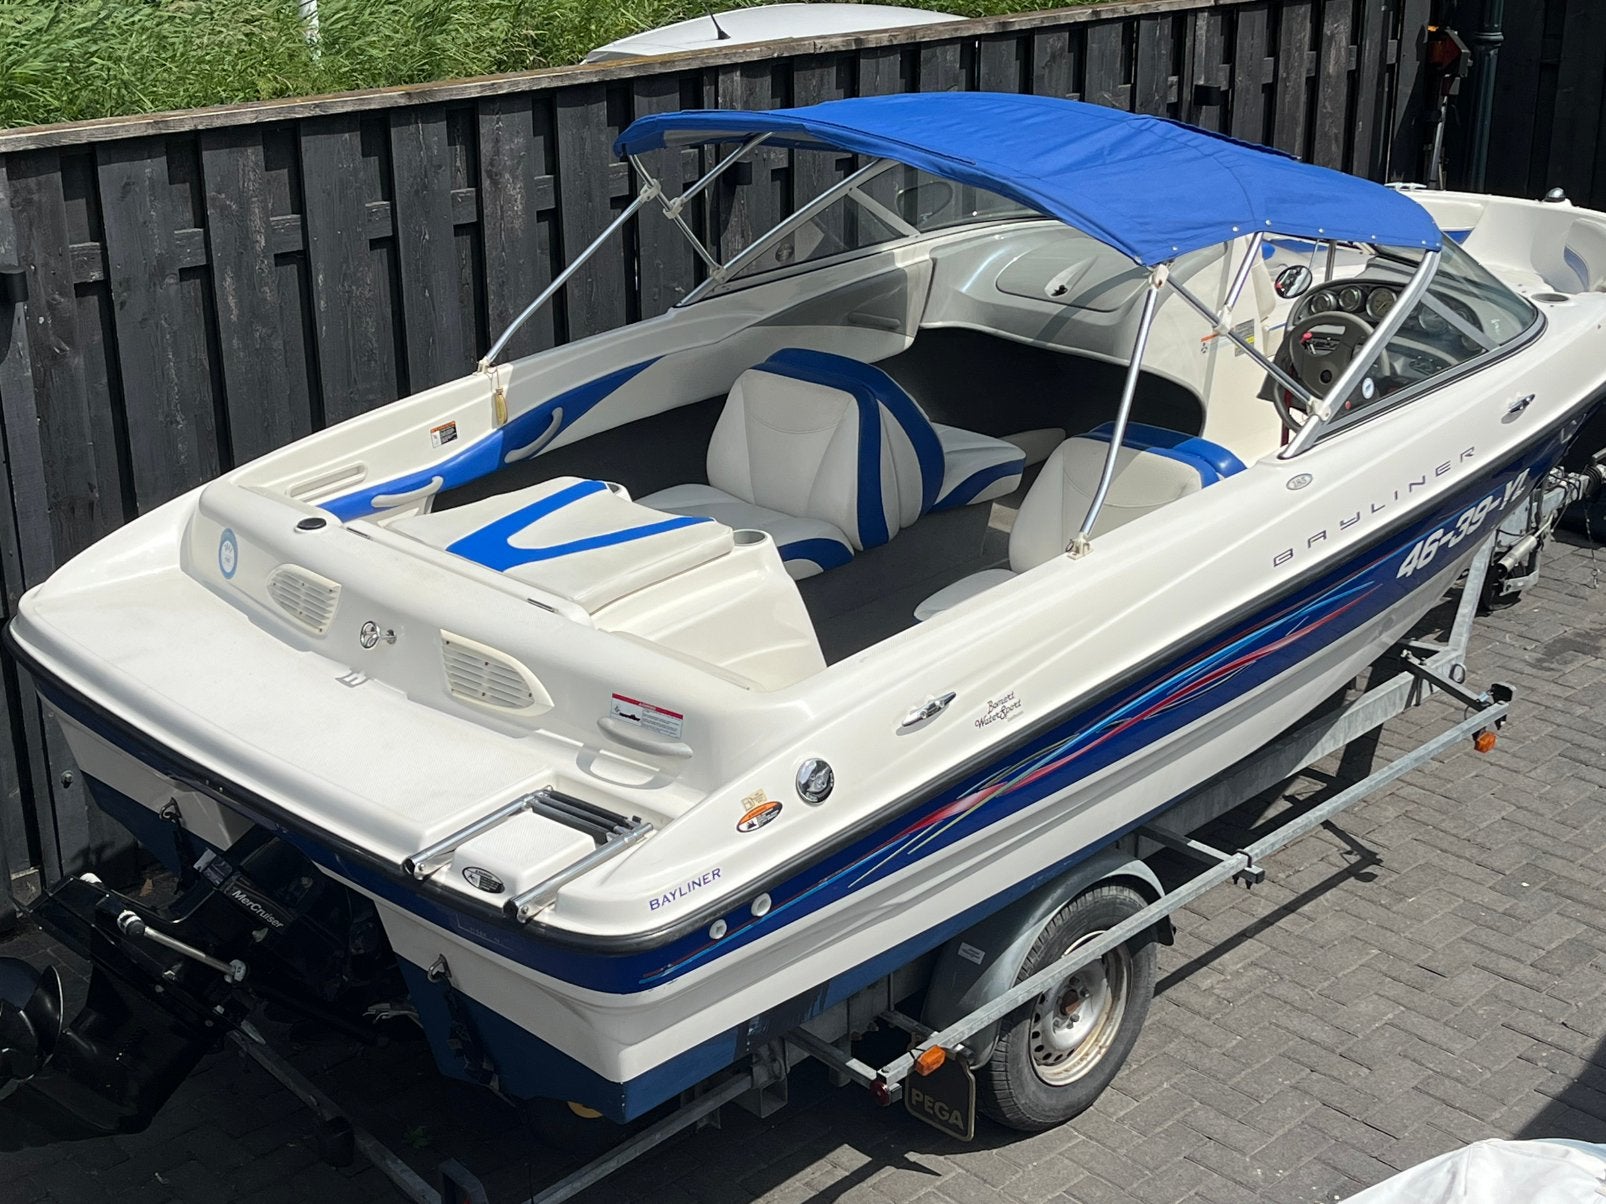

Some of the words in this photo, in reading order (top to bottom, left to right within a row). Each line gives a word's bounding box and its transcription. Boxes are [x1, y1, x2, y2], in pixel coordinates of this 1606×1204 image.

[1273, 446, 1475, 567] BAYLINER
[231, 889, 284, 928] MerCruiser
[649, 867, 721, 911] BAYLINER
[911, 1088, 964, 1131] PEGA
